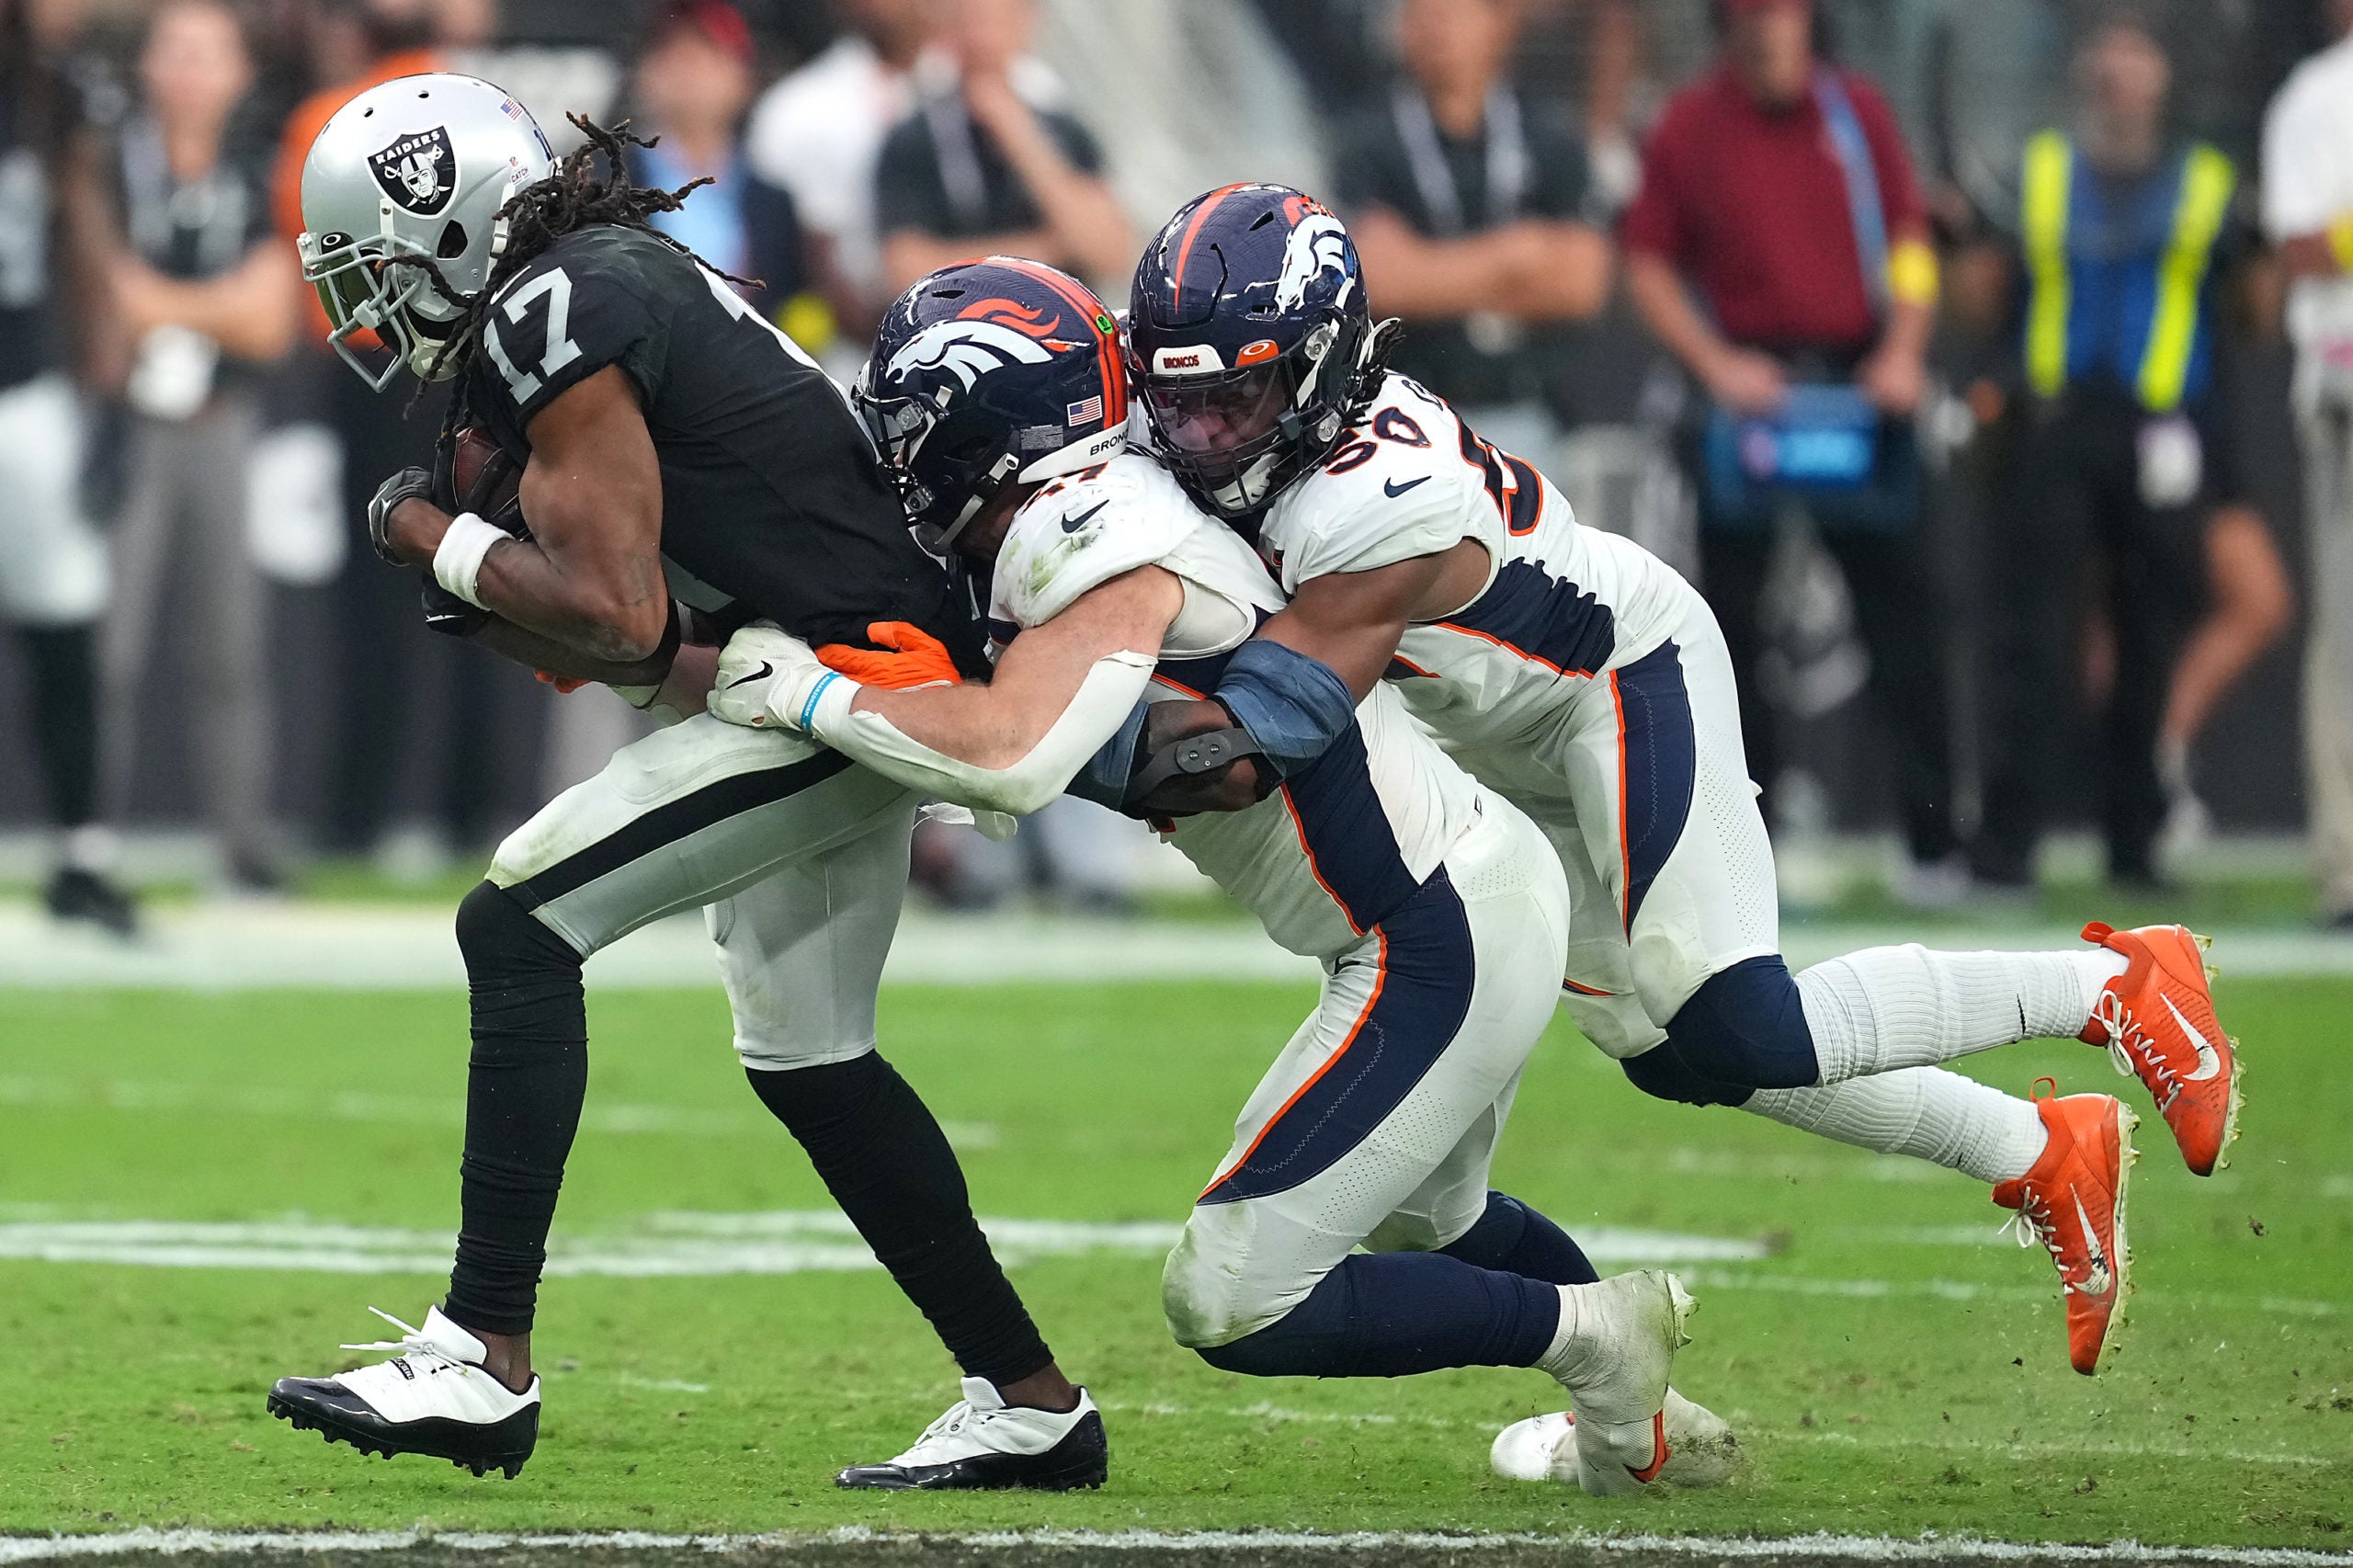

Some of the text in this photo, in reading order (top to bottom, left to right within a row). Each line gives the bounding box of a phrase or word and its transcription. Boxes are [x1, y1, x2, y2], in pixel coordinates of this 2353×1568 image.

[375, 131, 440, 165] RAIDERS
[483, 266, 583, 405] 17
[1163, 354, 1200, 369] BRONCOS
